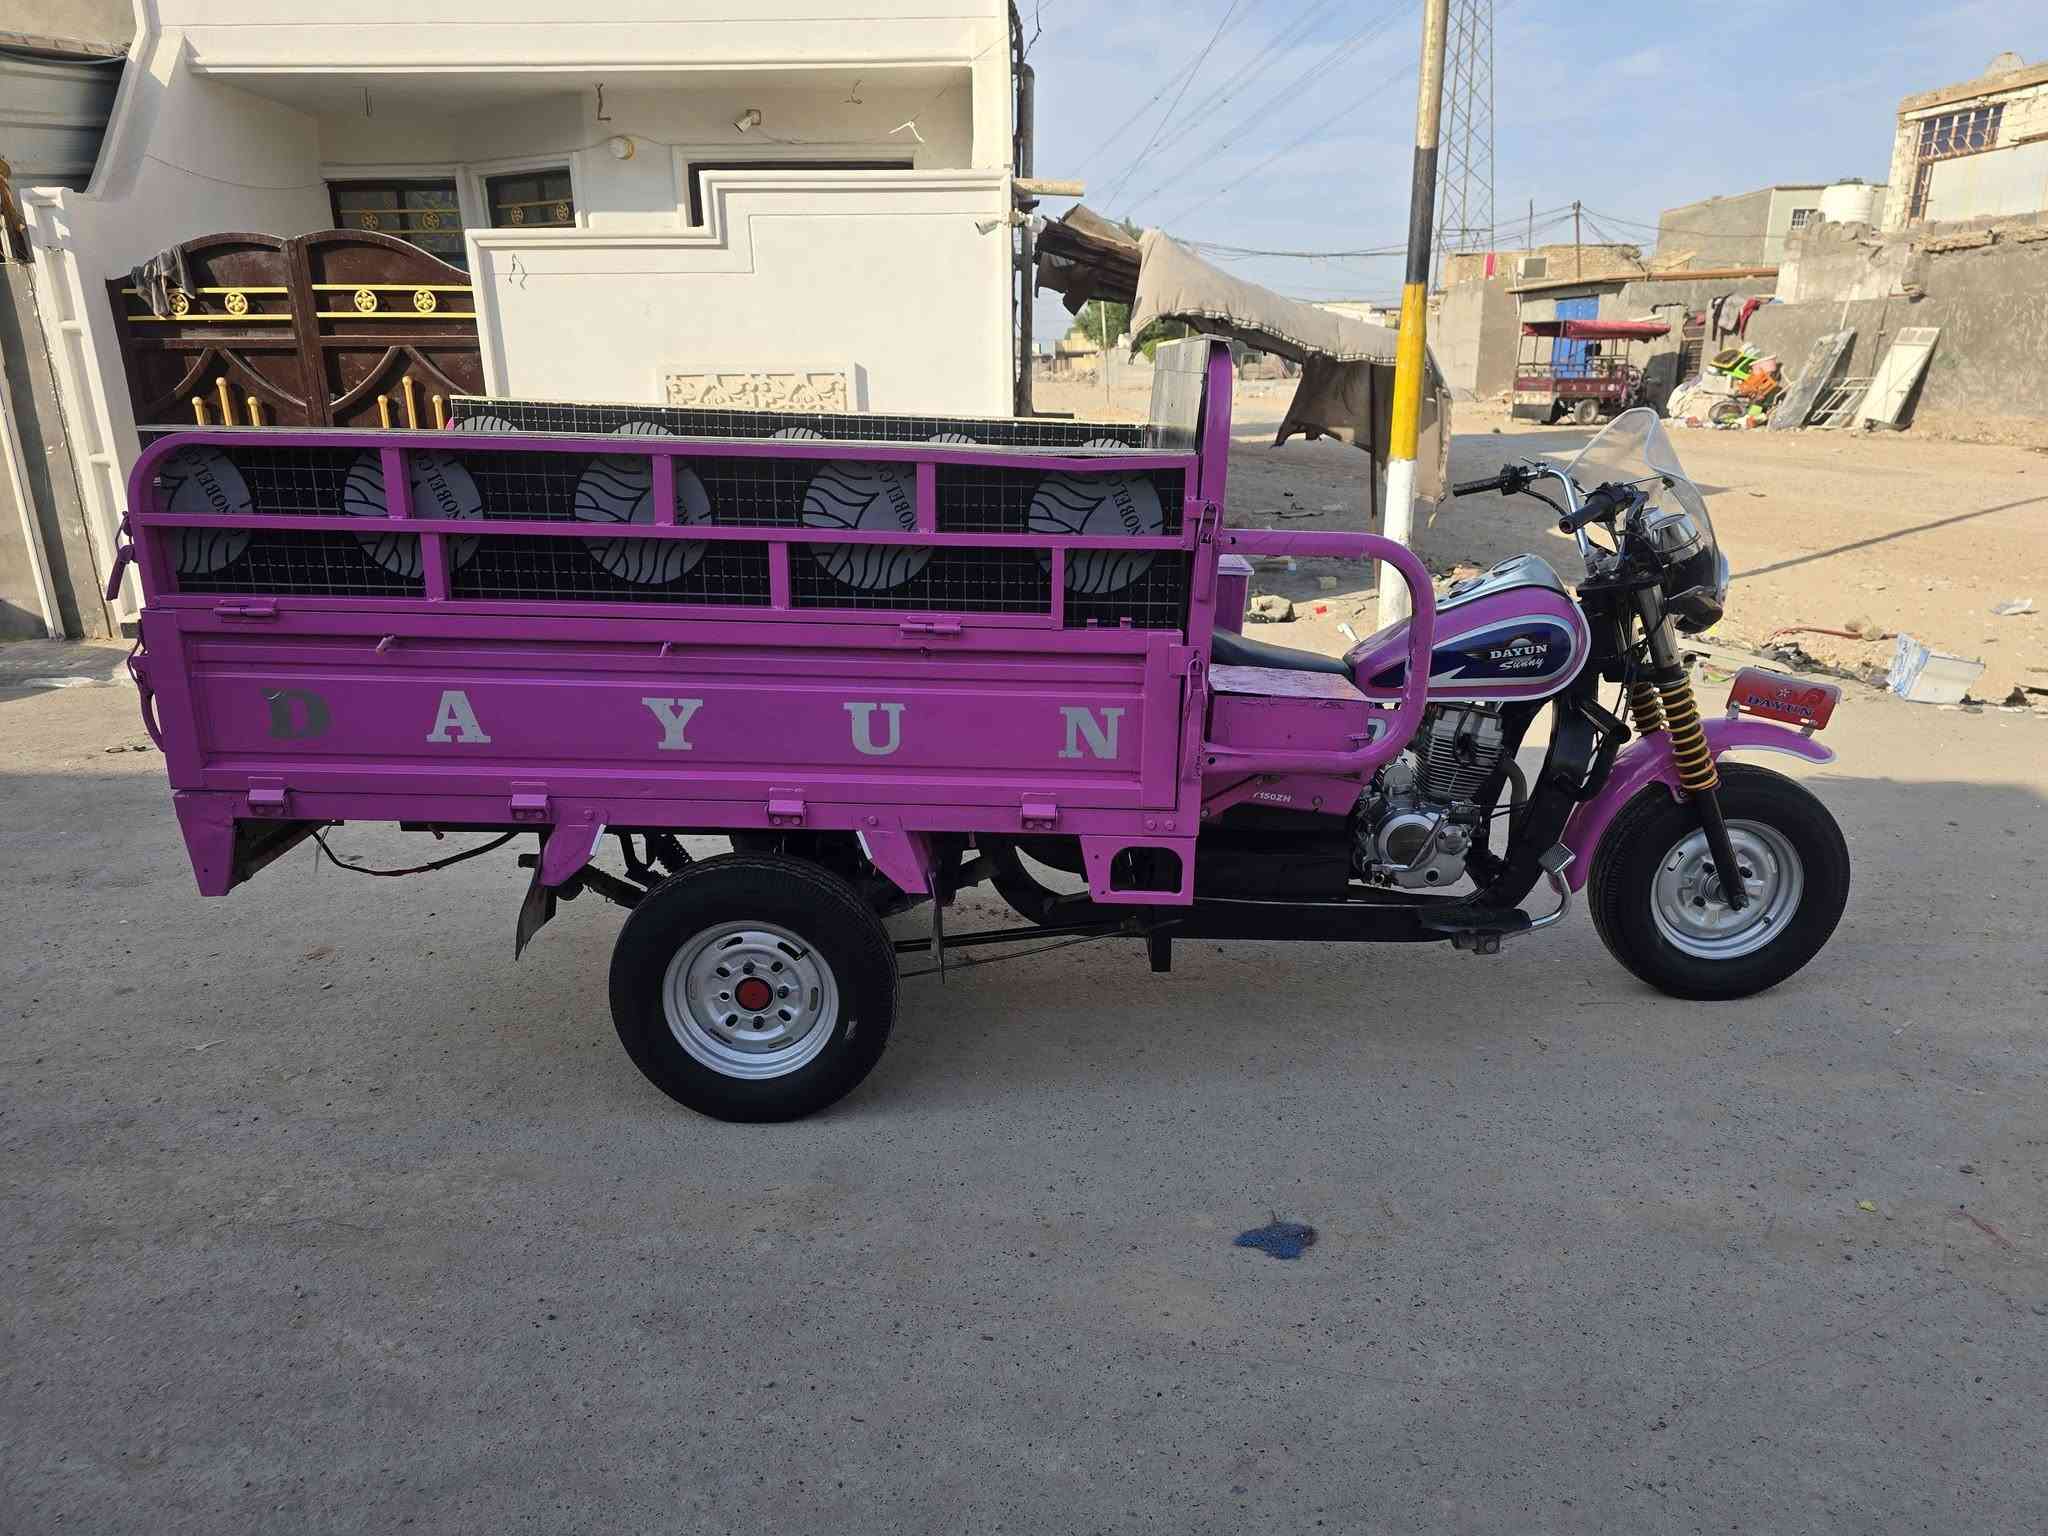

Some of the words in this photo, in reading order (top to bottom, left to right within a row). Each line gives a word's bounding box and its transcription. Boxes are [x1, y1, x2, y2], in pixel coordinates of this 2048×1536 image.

[1490, 644, 1548, 659] DAYUN
[1499, 657, 1544, 671] Sunny
[1748, 694, 1813, 717] DAYUN
